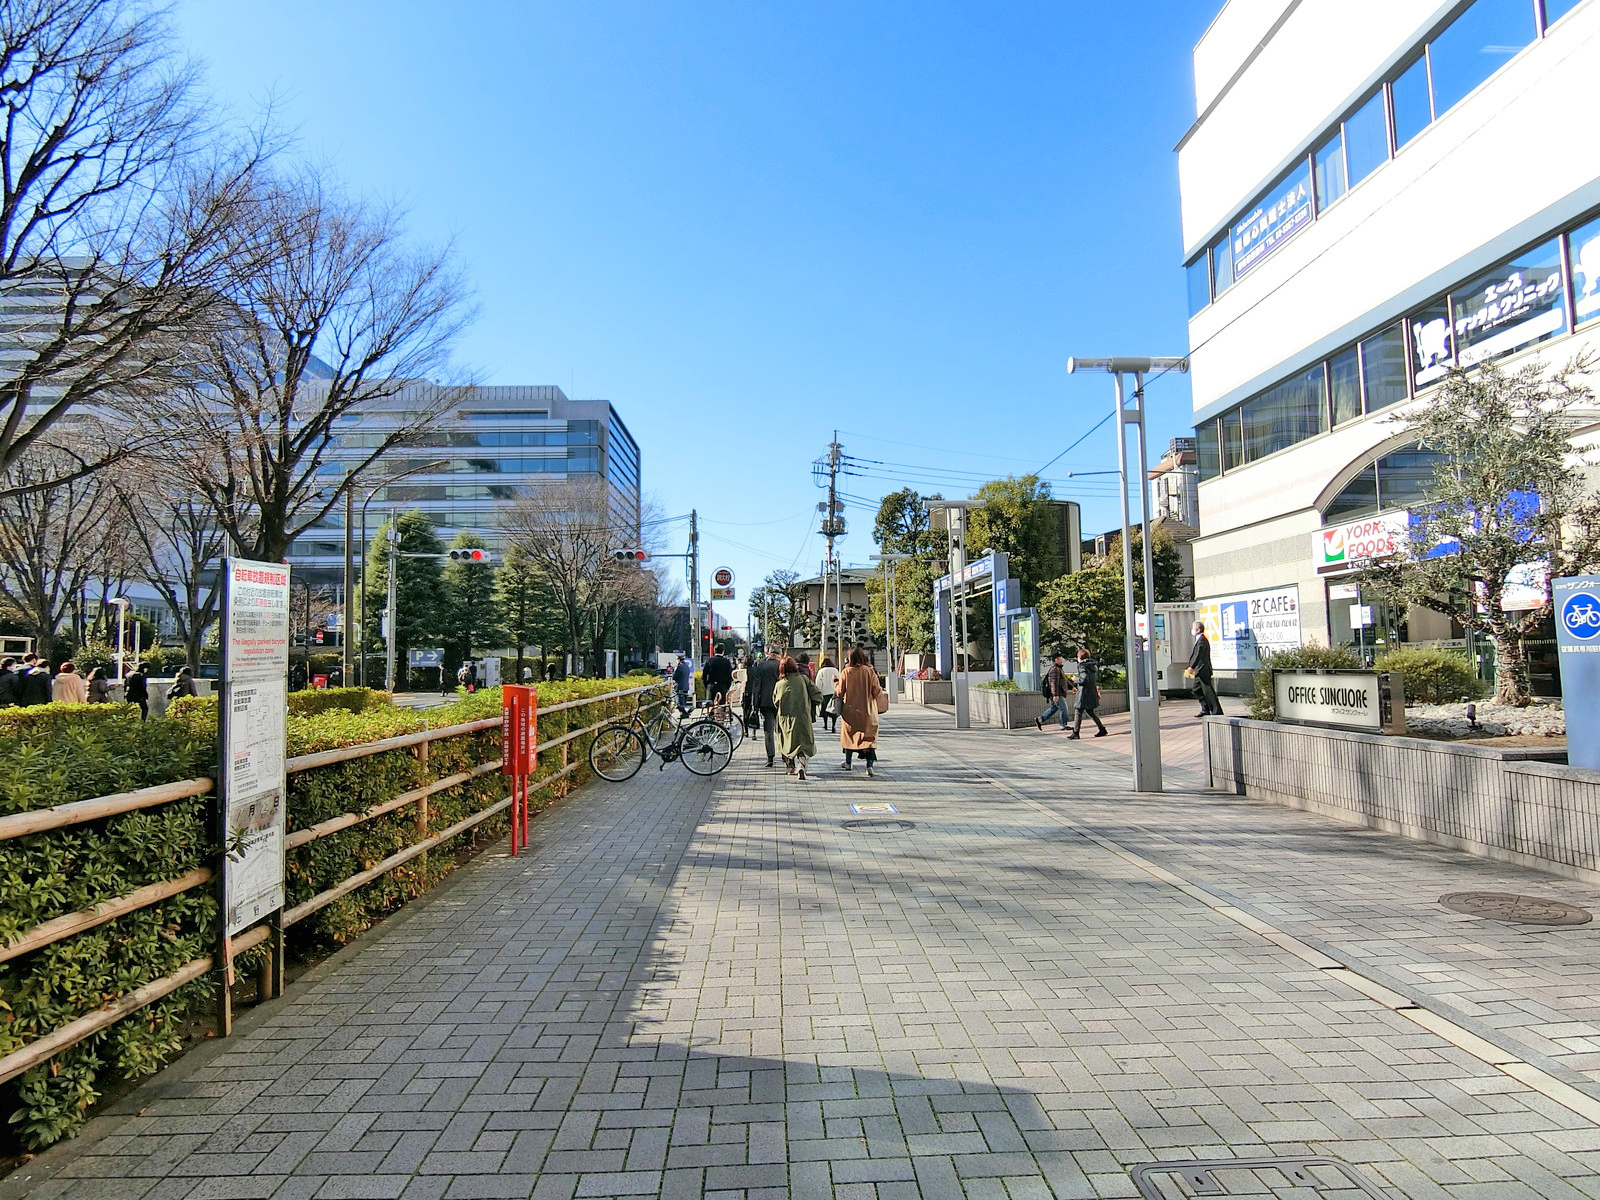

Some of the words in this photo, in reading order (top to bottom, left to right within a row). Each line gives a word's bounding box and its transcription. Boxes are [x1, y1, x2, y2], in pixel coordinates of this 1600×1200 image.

[1484, 272, 1522, 303] エース
[1455, 272, 1560, 335] デンタルクリニック
[1346, 520, 1381, 540] YORK
[1348, 535, 1394, 559] FOODS
[235, 568, 287, 586] 自転車放置規制区域
[1251, 599, 1261, 615] 2F
[1263, 596, 1288, 613] CAFE
[1252, 618, 1264, 631] Cafe
[241, 638, 257, 647] illegally
[257, 638, 271, 646] parked
[271, 638, 286, 646] bicycle
[243, 648, 265, 656] regulation
[416, 650, 425, 661] P
[1288, 685, 1316, 704] OFFICE
[1319, 687, 1368, 708] SUNCUORE
[1331, 708, 1368, 717] オフィスサンクォーレ
[249, 804, 255, 817] 月
[273, 795, 279, 807] 日
